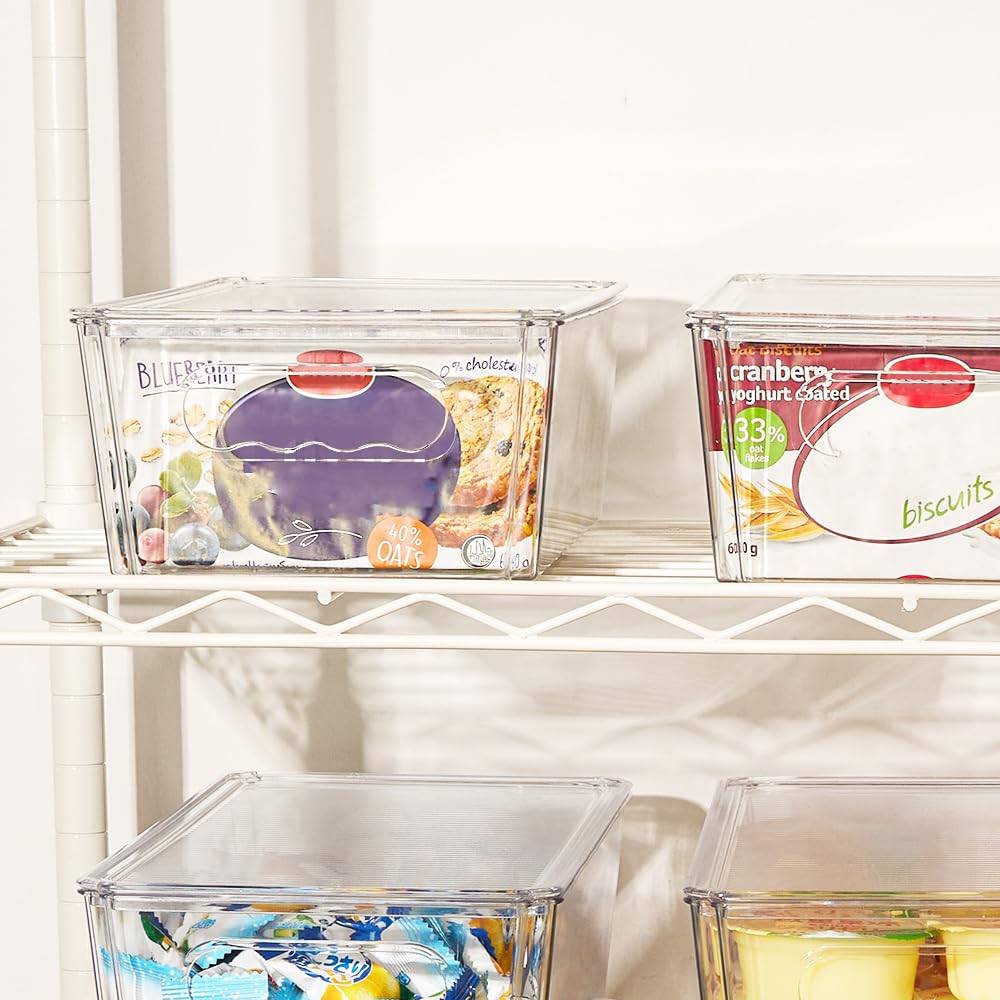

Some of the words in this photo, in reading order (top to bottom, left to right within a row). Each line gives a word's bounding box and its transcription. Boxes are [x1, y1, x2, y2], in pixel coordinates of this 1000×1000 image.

[731, 385, 792, 405] yoghurt
[736, 418, 785, 443] 33%
[903, 475, 994, 529] biscuits
[388, 523, 423, 546] 40%
[377, 541, 424, 569] OATS
[750, 544, 758, 557] g
